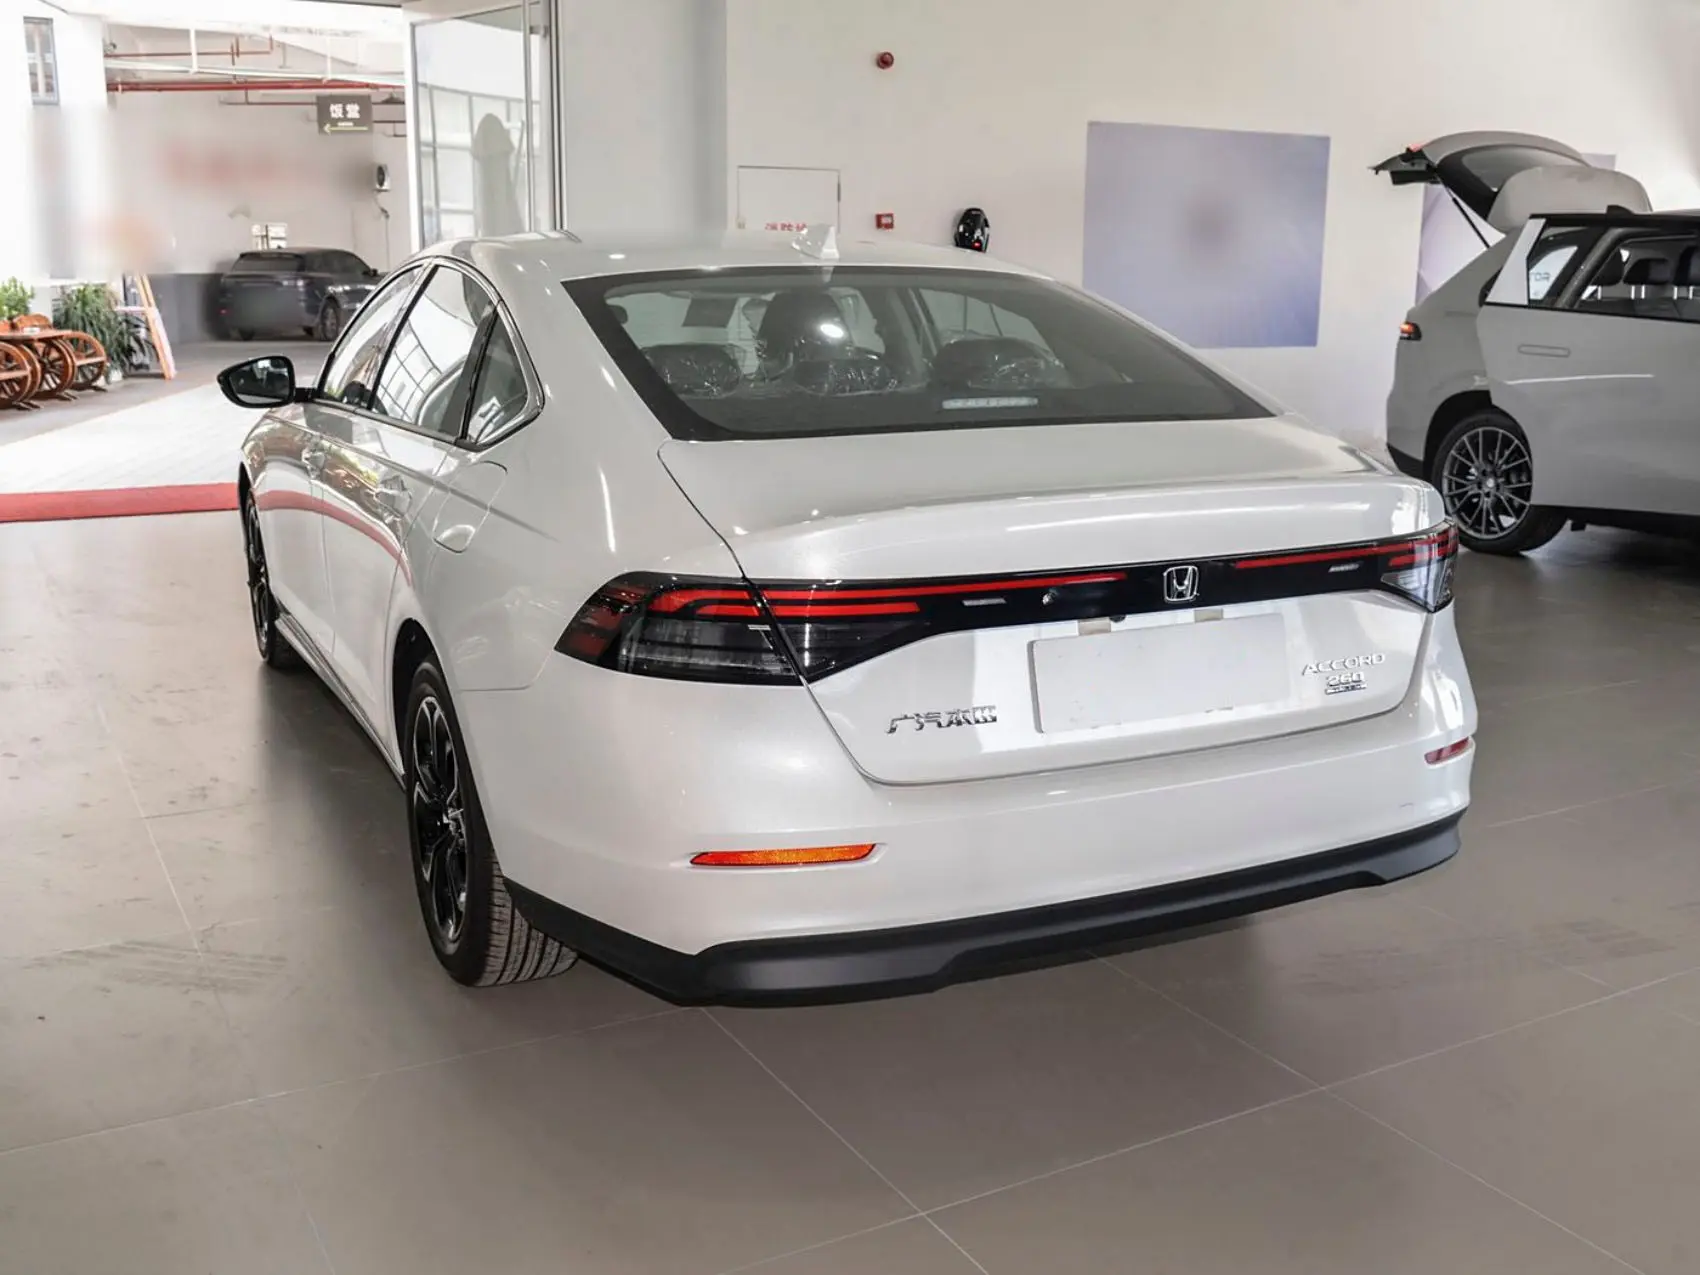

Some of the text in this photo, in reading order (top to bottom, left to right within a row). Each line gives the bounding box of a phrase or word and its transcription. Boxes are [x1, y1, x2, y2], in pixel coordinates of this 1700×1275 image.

[1301, 653, 1386, 676] ACCORD
[1326, 671, 1365, 687] 260
[884, 705, 998, 734] 广汽本田
